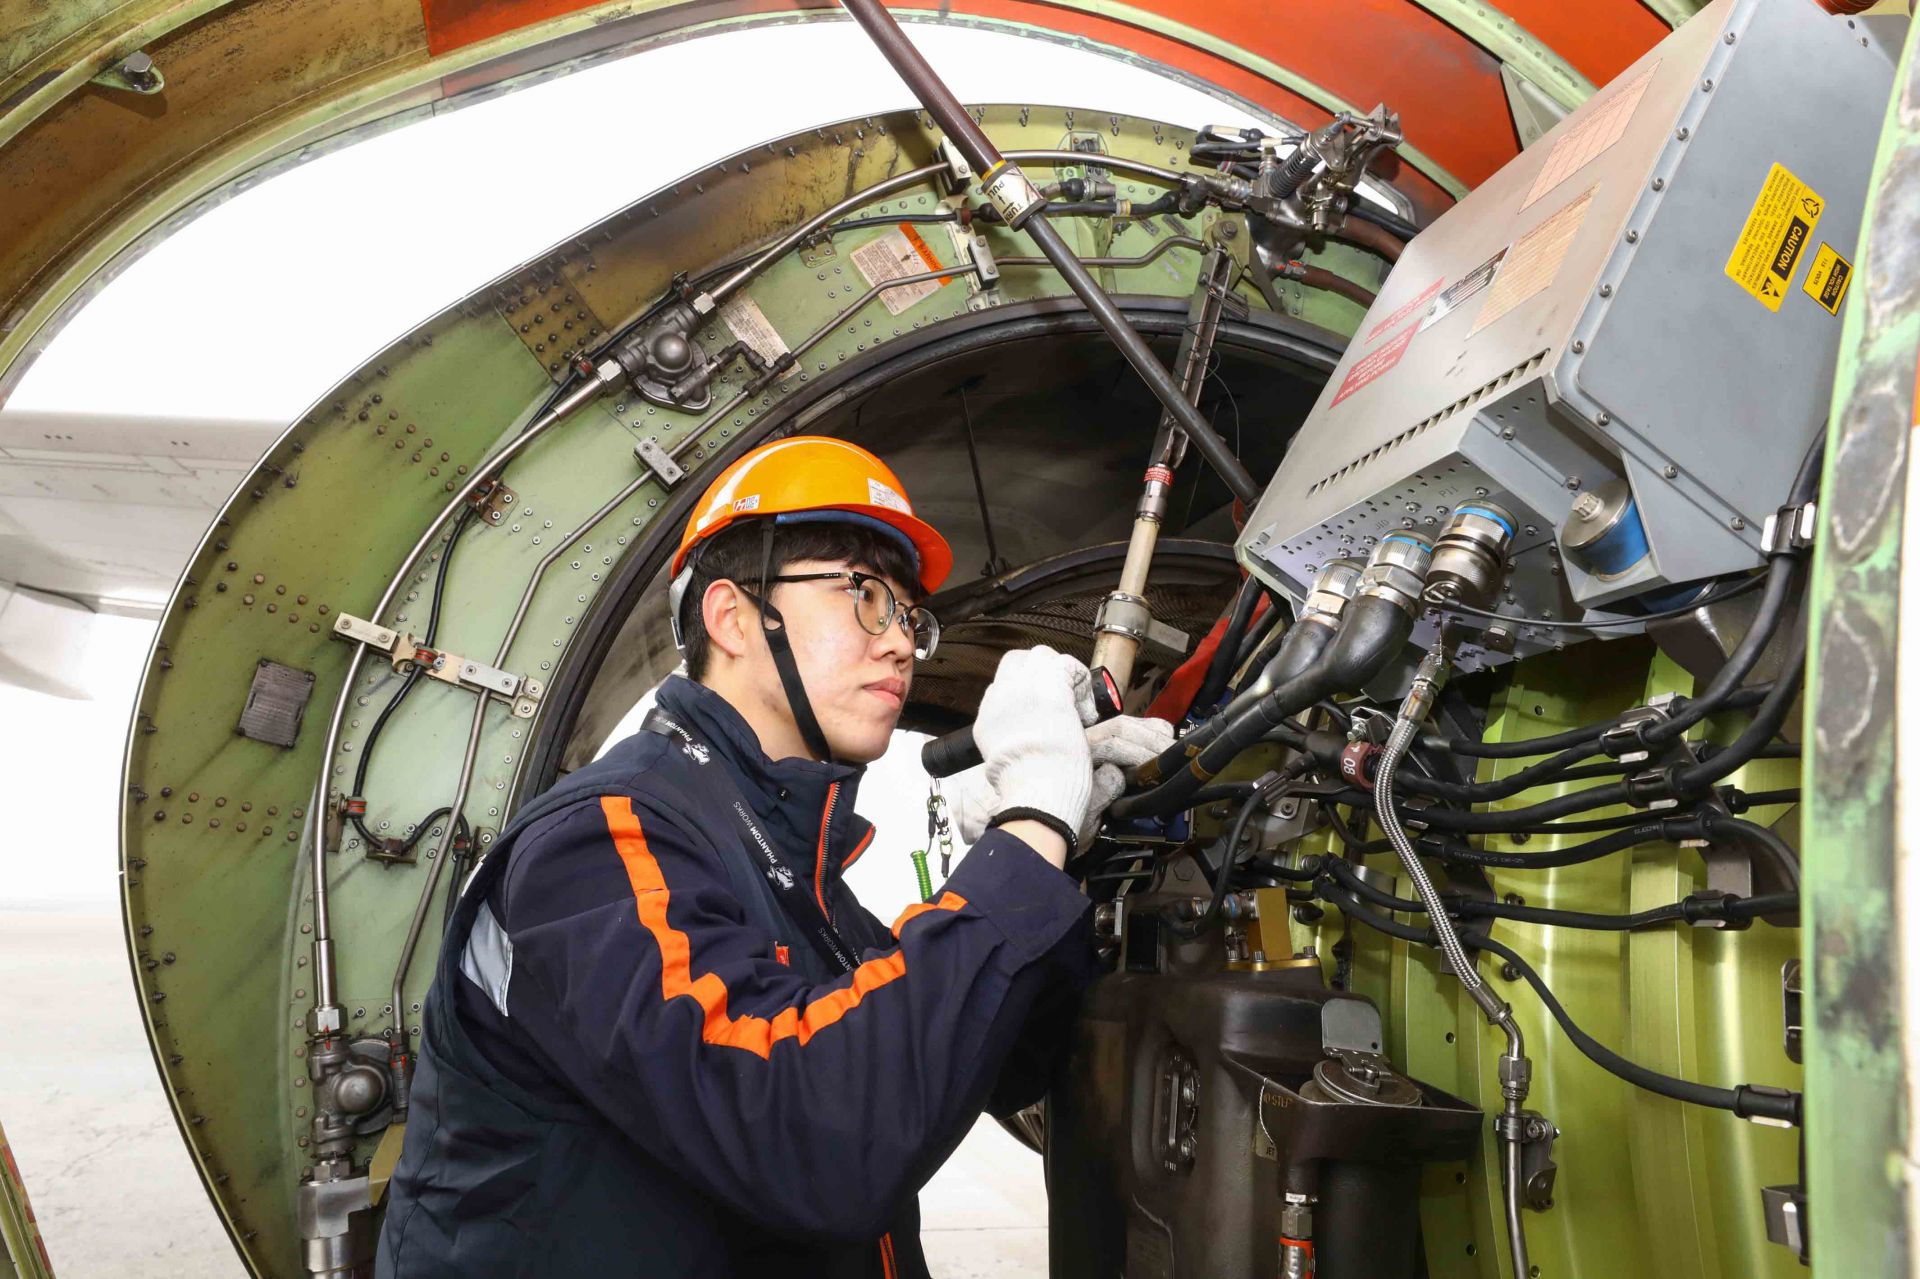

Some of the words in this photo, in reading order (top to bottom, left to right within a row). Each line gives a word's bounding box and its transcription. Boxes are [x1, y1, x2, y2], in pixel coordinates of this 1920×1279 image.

[985, 180, 1006, 200] PULL
[1776, 224, 1803, 271] CAUTION
[817, 926, 854, 971] NTOMWORKS
